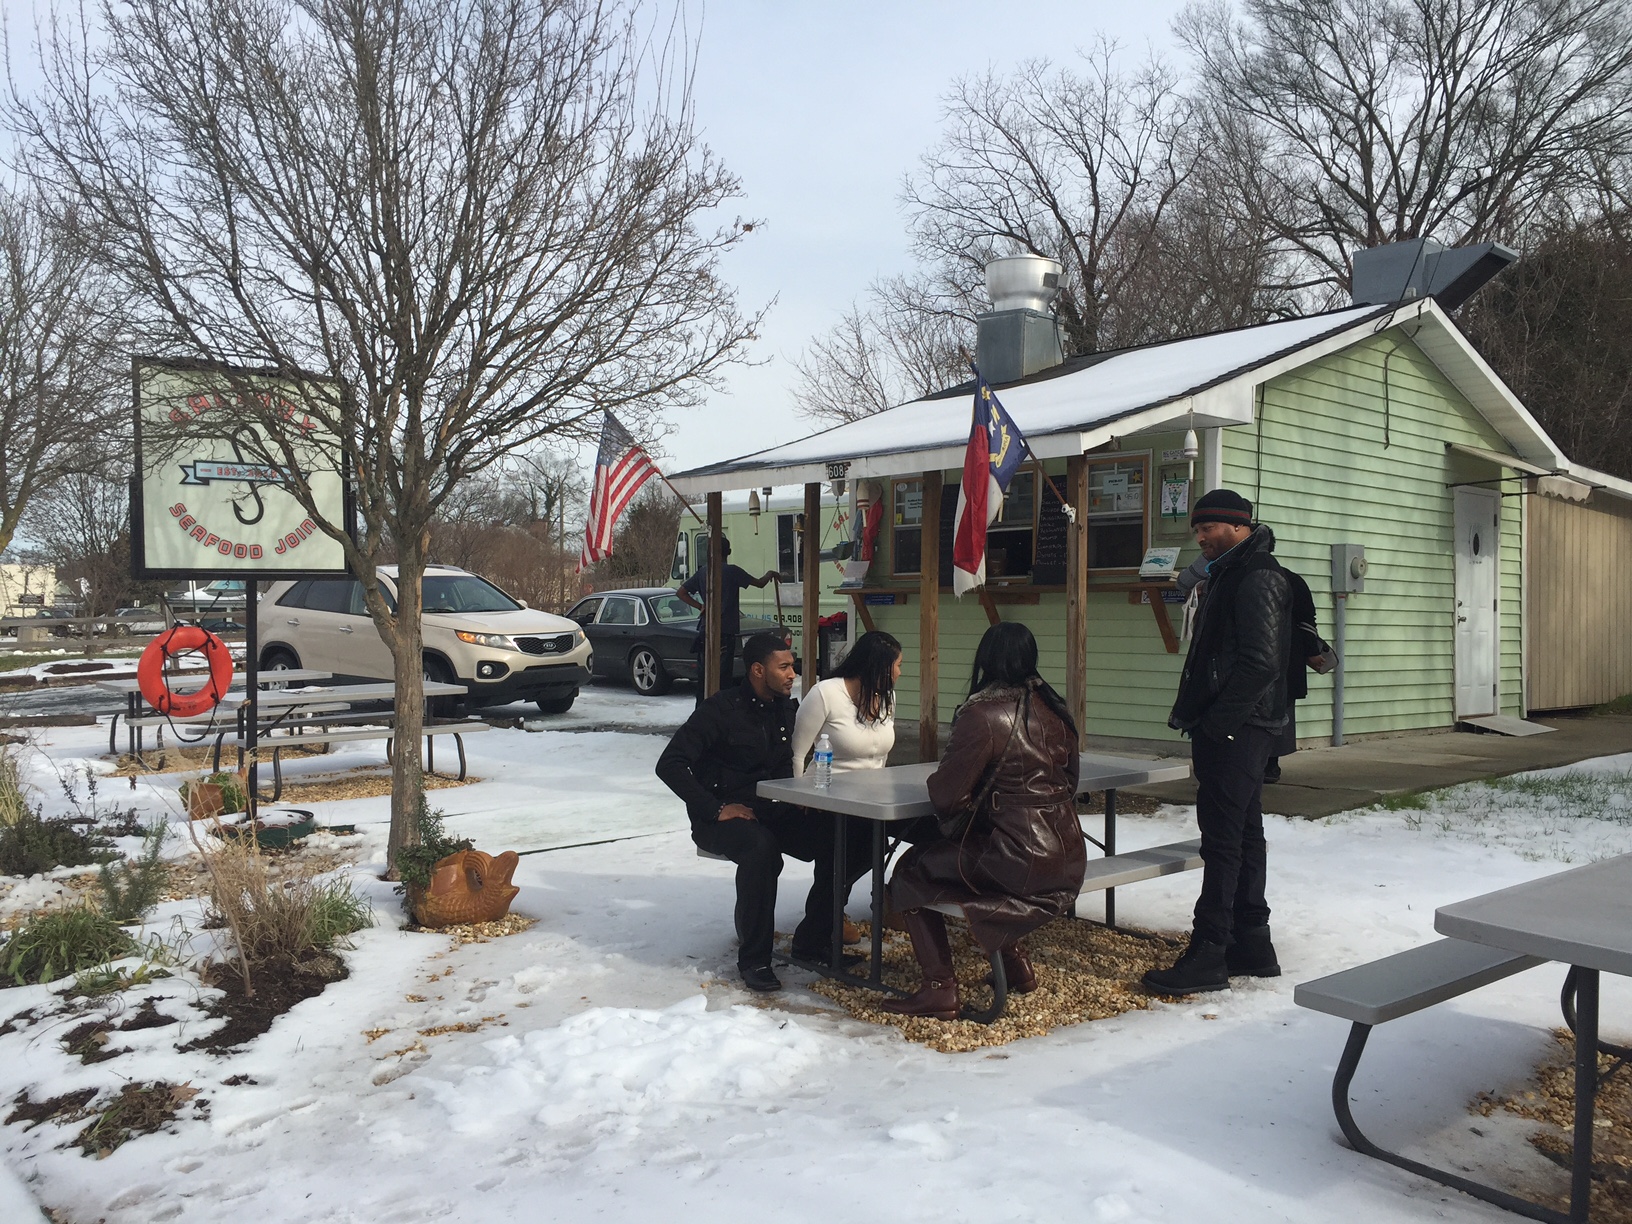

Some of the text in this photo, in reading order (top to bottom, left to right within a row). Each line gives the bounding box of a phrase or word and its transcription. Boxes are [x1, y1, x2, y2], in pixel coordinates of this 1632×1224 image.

[828, 465, 844, 478] 608
[169, 502, 318, 560] SEAFOOD JOIN
